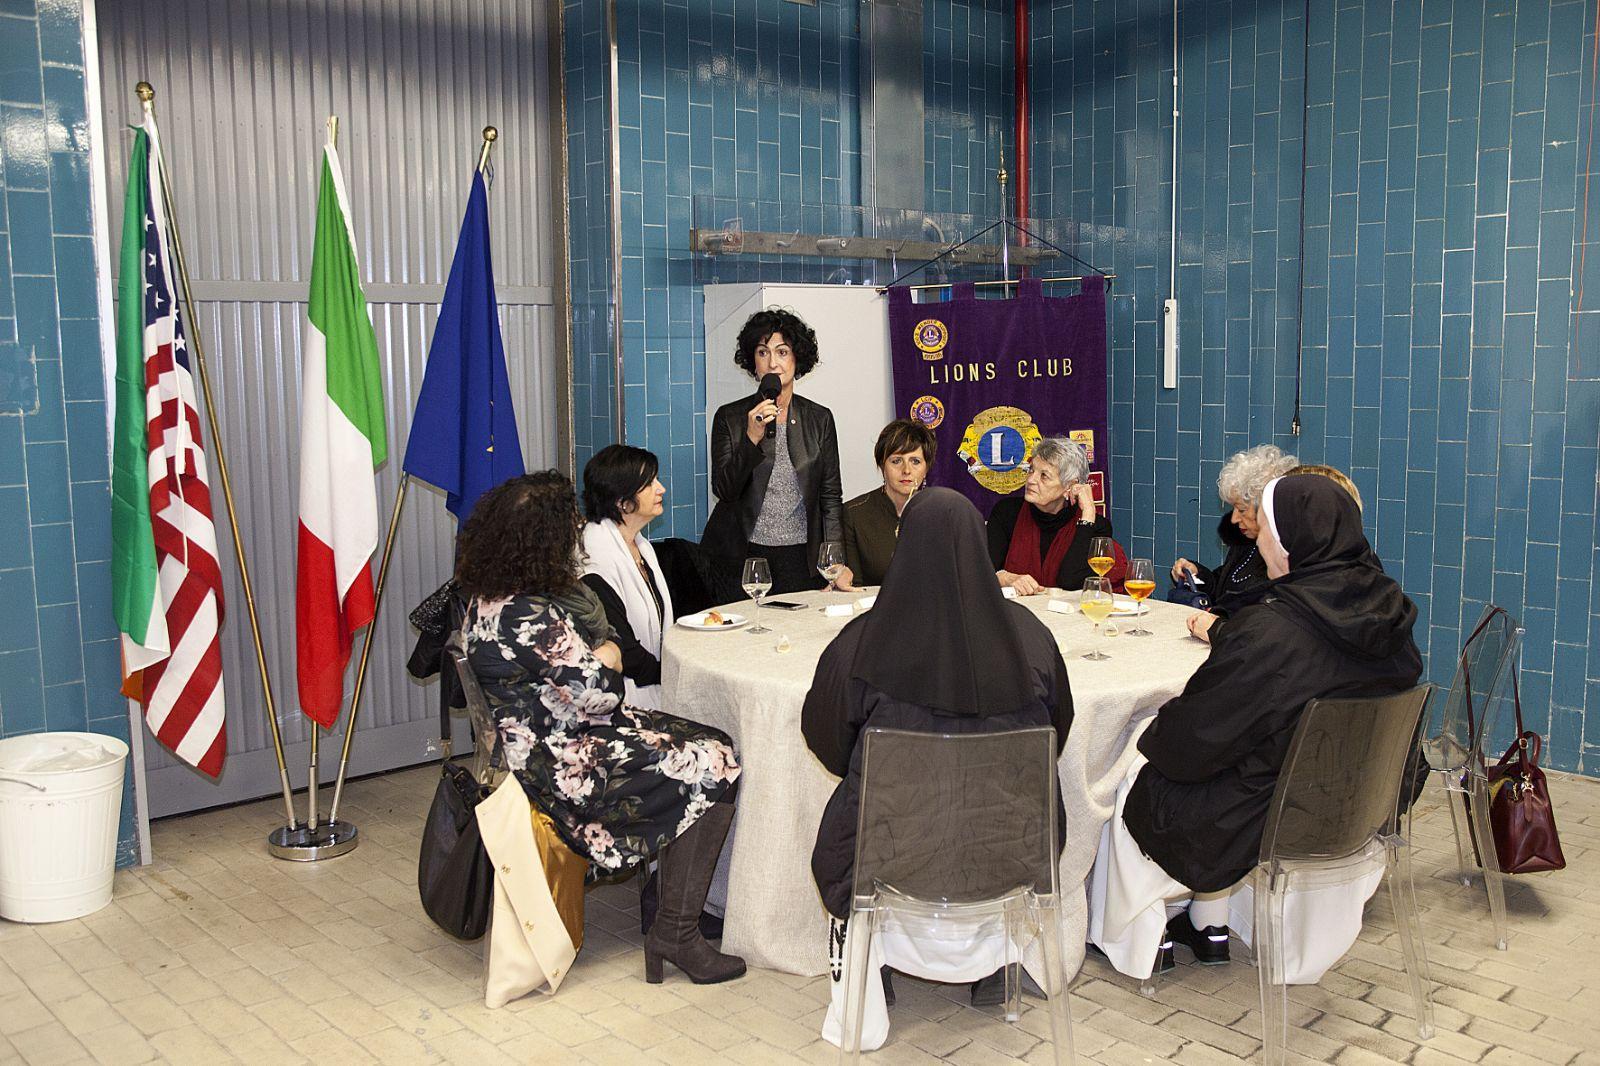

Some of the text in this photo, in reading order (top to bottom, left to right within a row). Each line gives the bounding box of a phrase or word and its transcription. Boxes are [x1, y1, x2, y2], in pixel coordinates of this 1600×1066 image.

[930, 358, 1074, 385] LIONS CLUB
[990, 432, 1015, 465] L
